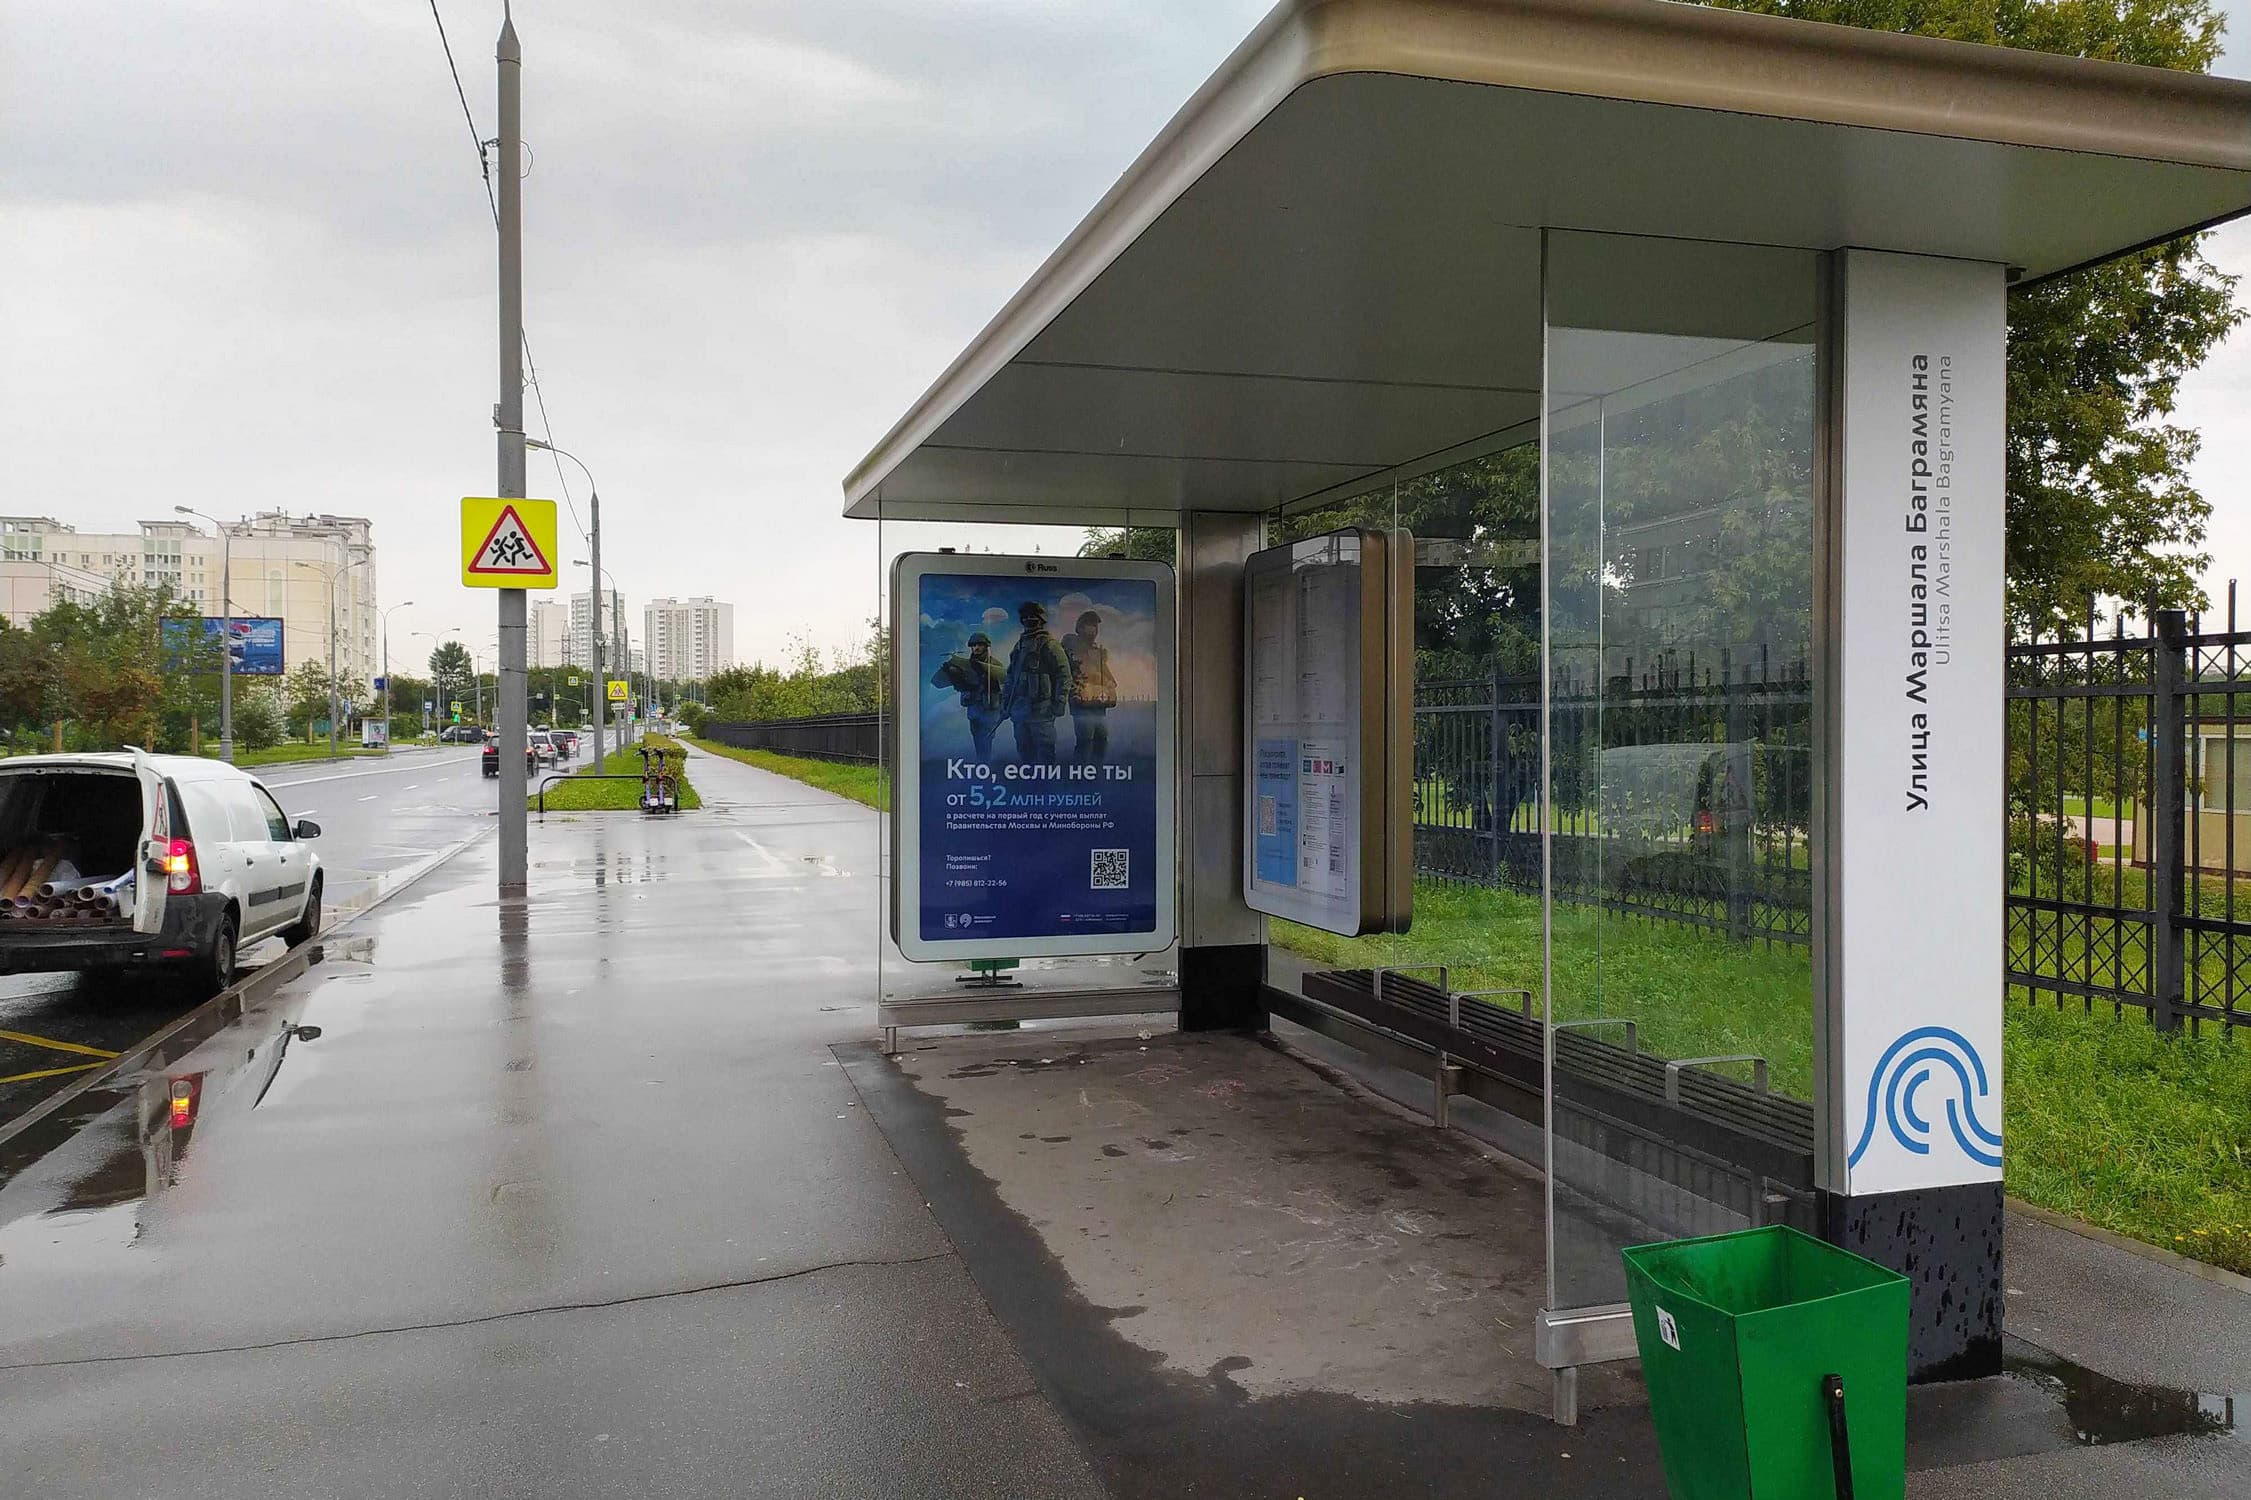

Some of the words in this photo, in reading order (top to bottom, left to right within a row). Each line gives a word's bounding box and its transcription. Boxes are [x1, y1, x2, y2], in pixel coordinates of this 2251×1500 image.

[1905, 354, 1932, 534] Баграмяна
[1936, 355, 1954, 489] Bagramyana
[1936, 498, 1952, 598] Marshala
[1906, 544, 1932, 704] Маршала
[1936, 604, 1951, 665] Ulitsa
[947, 758, 997, 784] Кто,
[1004, 763, 1061, 780] если
[1069, 764, 1097, 780] не
[1102, 764, 1132, 780] ты
[969, 785, 1006, 809] 5,2
[1049, 792, 1102, 806] РУБЛЕЙ
[1906, 714, 1931, 812] Улица
[946, 822, 1006, 830] Правительства
[1049, 822, 1101, 830] Минобороны
[1102, 821, 1115, 829] РФ
[998, 811, 1028, 820] первый
